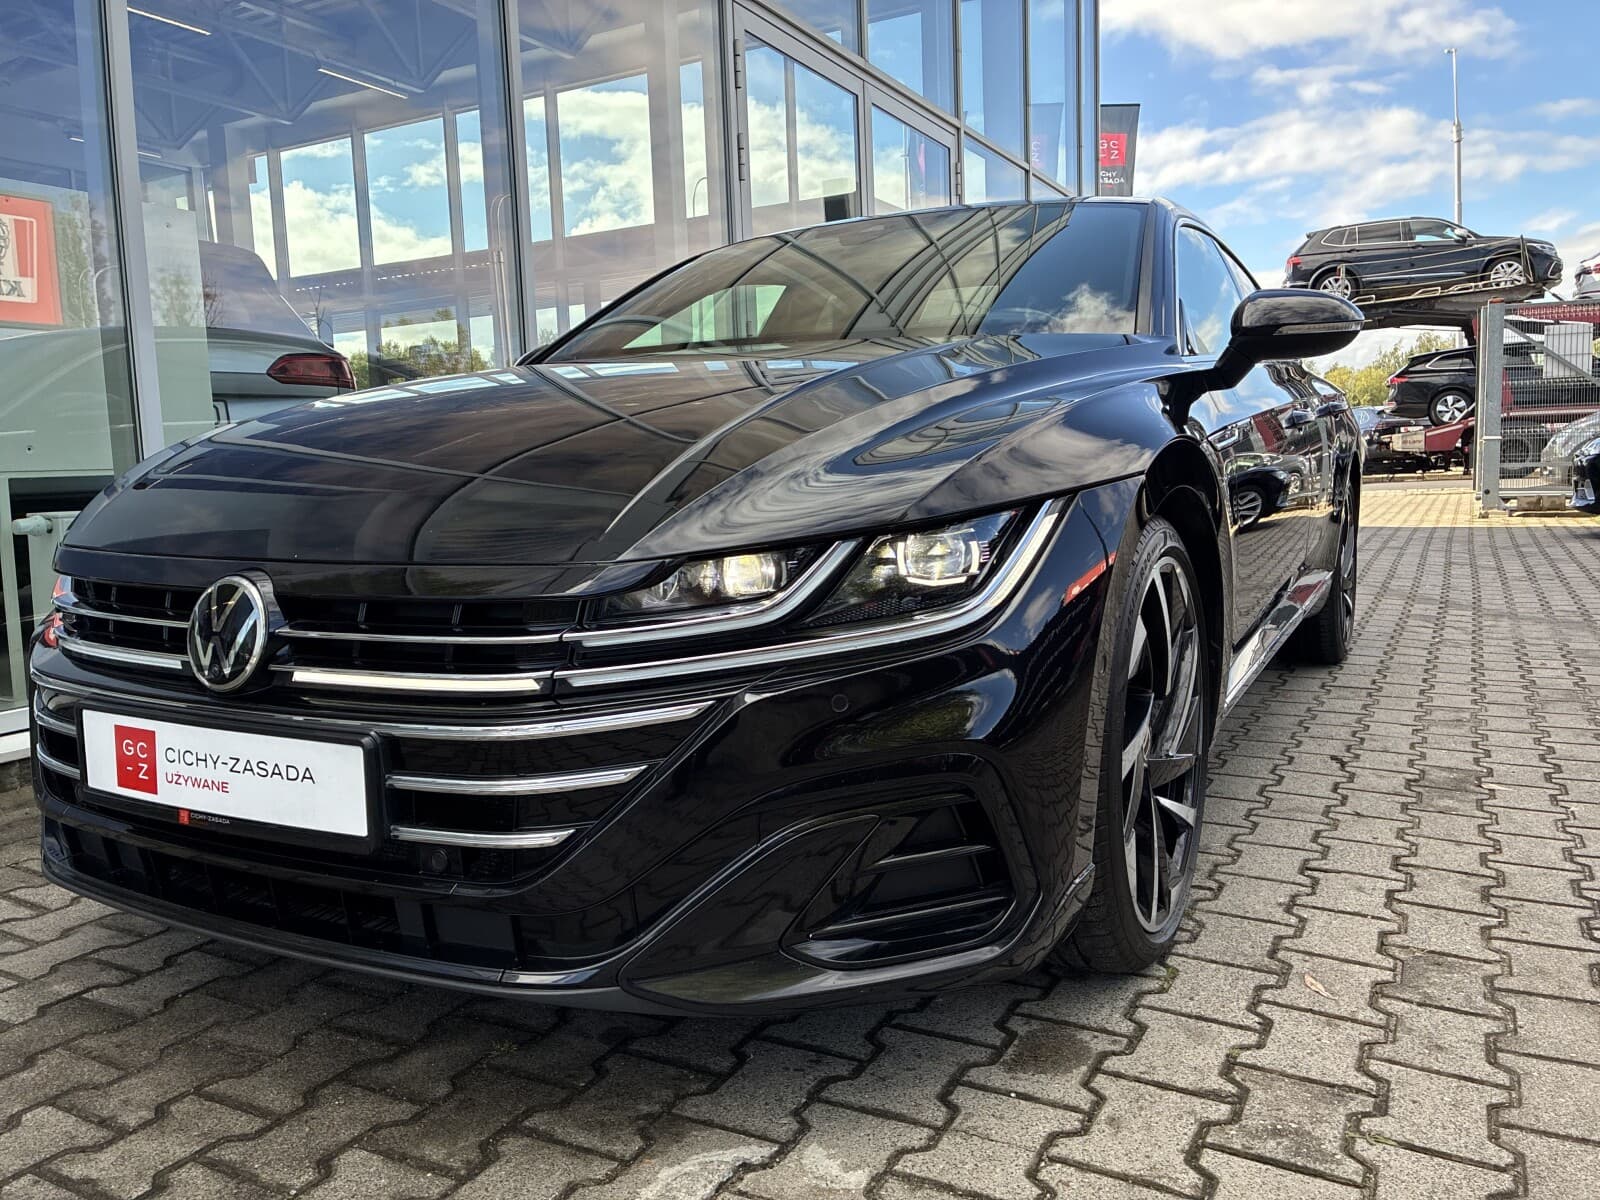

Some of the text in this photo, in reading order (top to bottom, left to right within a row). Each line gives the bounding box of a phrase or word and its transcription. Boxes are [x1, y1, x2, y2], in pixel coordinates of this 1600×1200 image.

[122, 739, 148, 759] GC
[164, 746, 316, 784] CICHY-ZASADA
[165, 771, 230, 794] UŻYWANE
